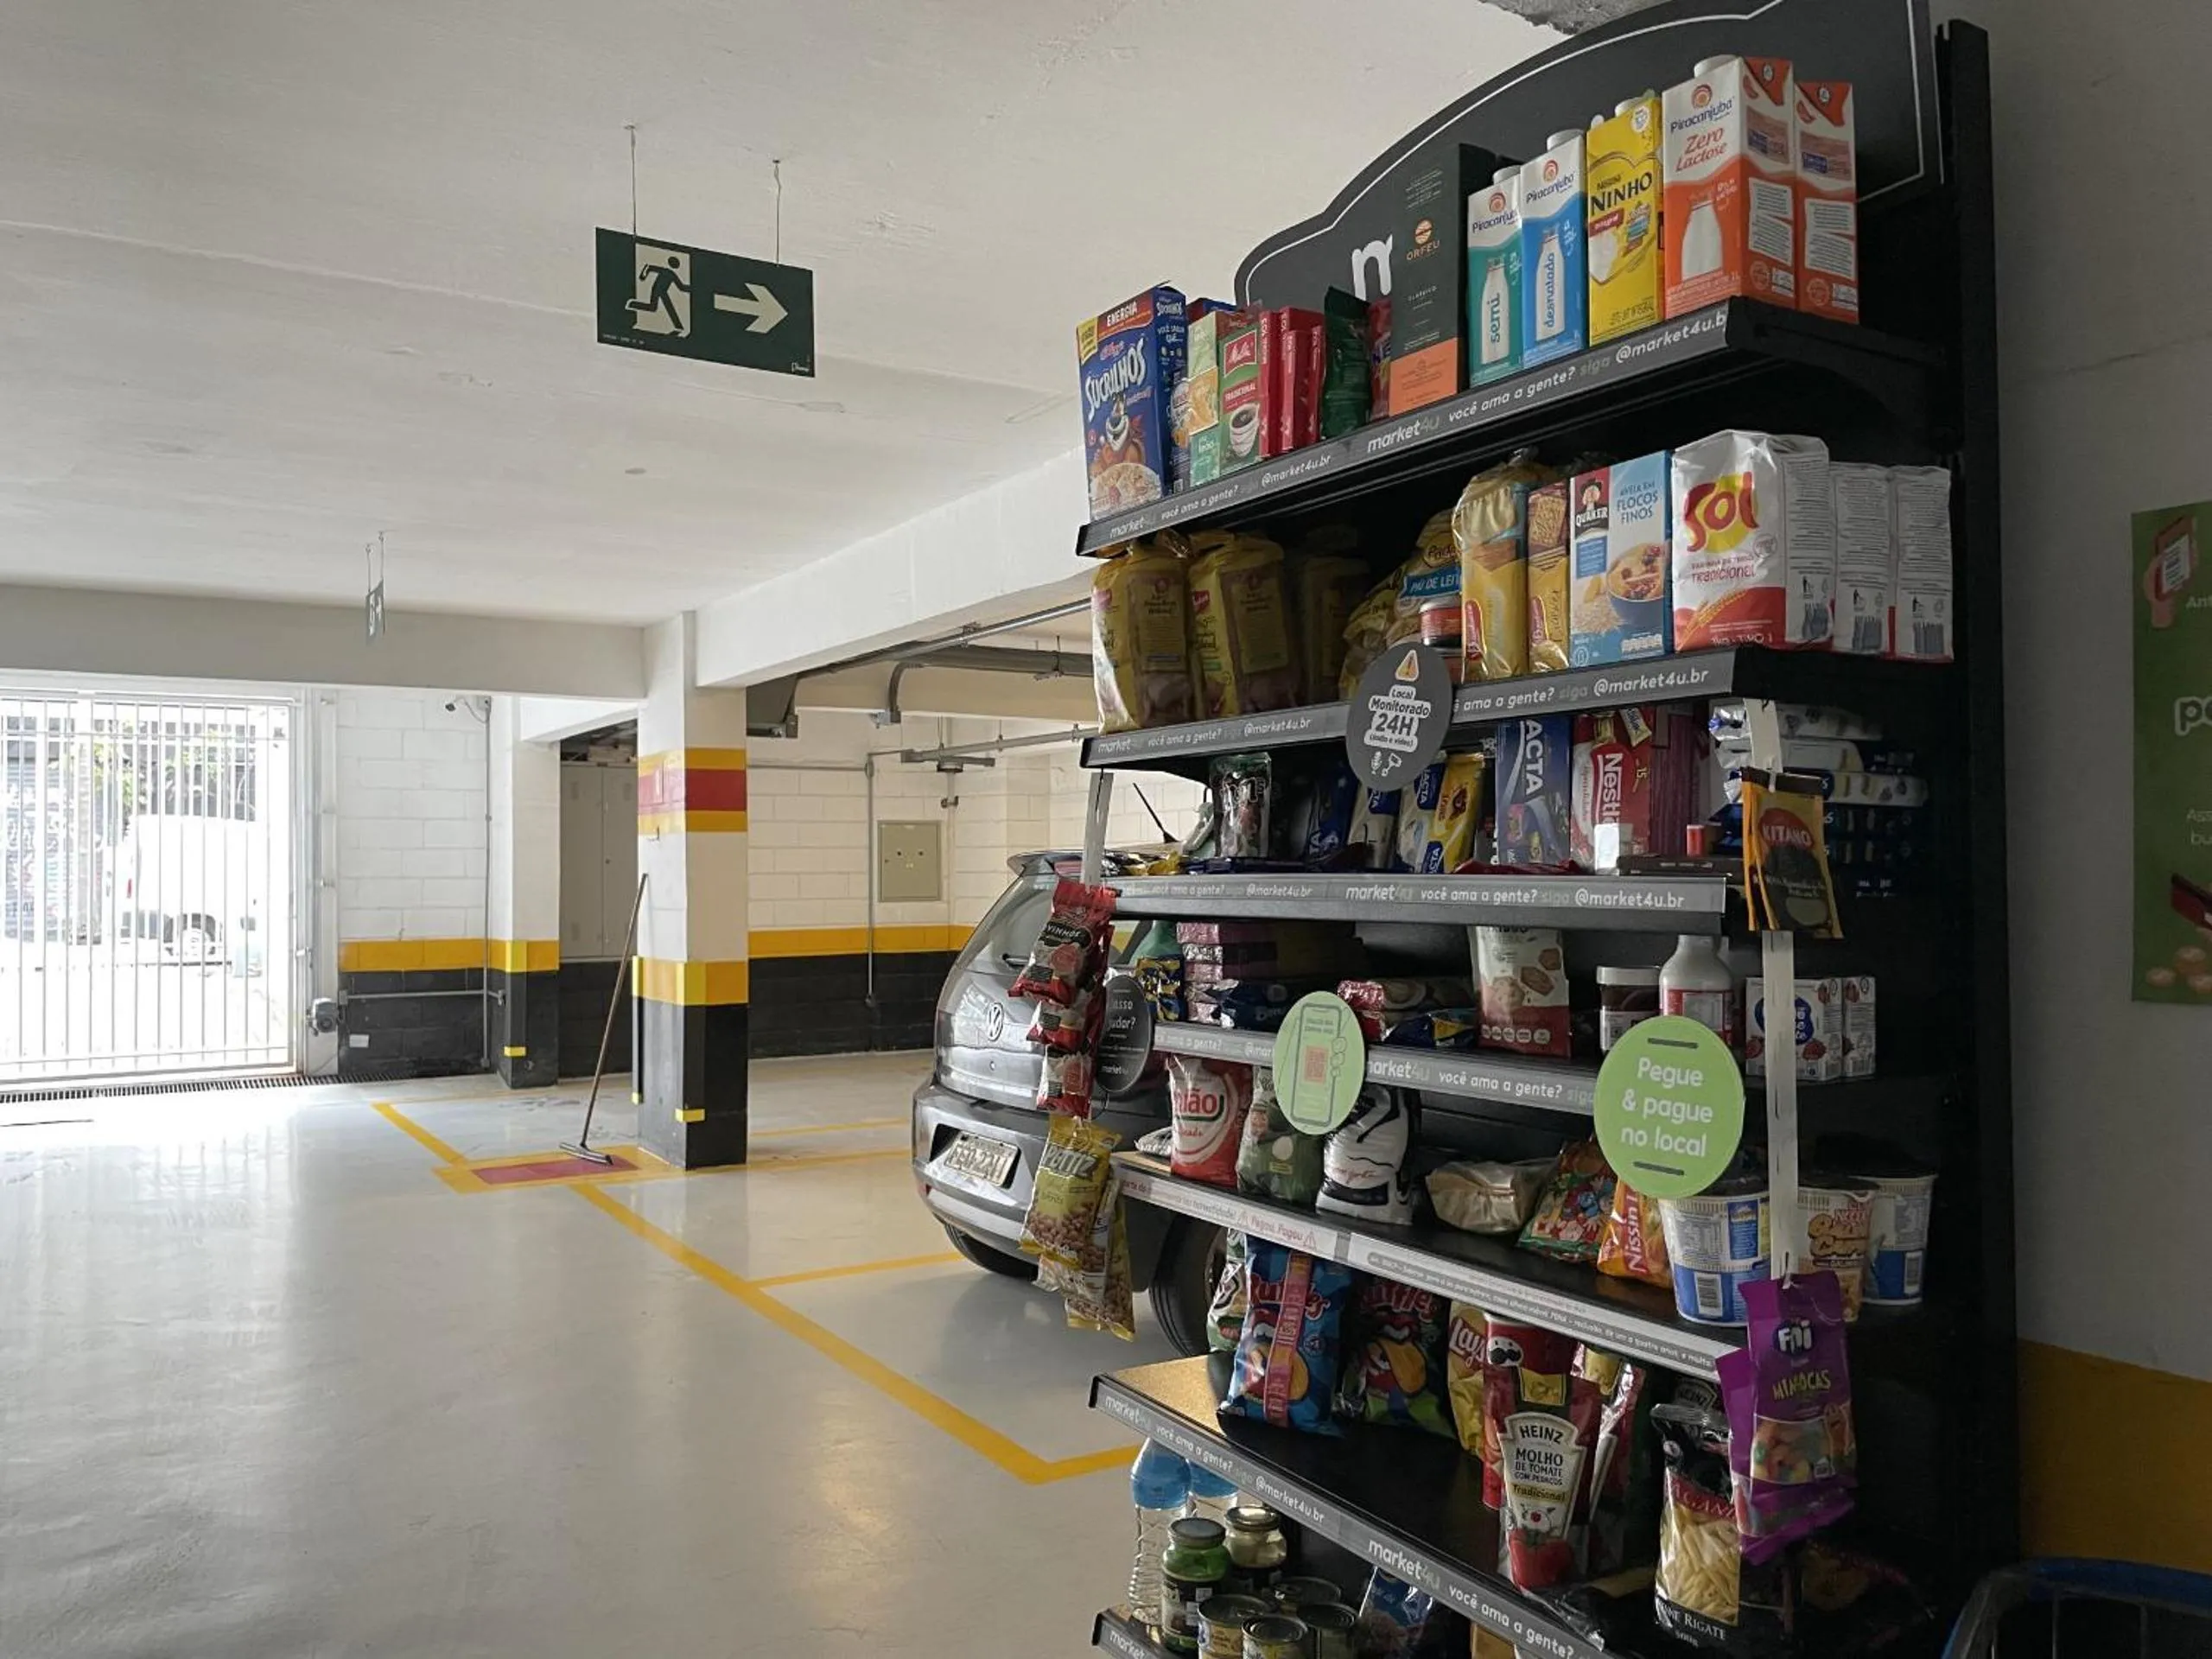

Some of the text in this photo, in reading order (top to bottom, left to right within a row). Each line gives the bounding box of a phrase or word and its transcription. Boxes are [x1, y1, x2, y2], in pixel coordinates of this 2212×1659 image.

[1684, 128, 1725, 156] Zero
[1675, 143, 1727, 173] Lactose
[1590, 172, 1653, 216] NINHO
[1490, 291, 1501, 345] semi
[1617, 491, 1659, 512] FLOCOS
[1575, 507, 1610, 526] QUAKER
[1621, 505, 1654, 525] FINOS
[1392, 689, 1414, 700] Local
[1463, 697, 1491, 711] ama
[1507, 686, 1555, 710] gente?
[1593, 668, 1710, 698] @market4u.br
[1370, 697, 1430, 716] Monitorado
[1375, 713, 1414, 736] 24H
[1761, 823, 1812, 849] KITANO
[1421, 887, 1447, 901] você
[1450, 891, 1478, 902] ama
[1493, 888, 1539, 906] gente?
[1574, 888, 1685, 909] @market4u.br
[1438, 1071, 1467, 1086] você
[1471, 1077, 1498, 1091] ama
[1515, 1081, 1563, 1099] gente?
[1637, 1057, 1704, 1090] Pegue
[1621, 1089, 1714, 1125] & pague
[1620, 1126, 1708, 1158] no local
[1626, 1208, 1647, 1274] Nissin
[1519, 1424, 1564, 1445] HEINZ
[1515, 1446, 1564, 1468] MOLHO
[1515, 1460, 1563, 1478] DE TOMATE
[1511, 1484, 1566, 1503] Tradicional
[1448, 1583, 1478, 1610] você
[1481, 1603, 1510, 1628] ama
[1526, 1627, 1574, 1658] gente?
